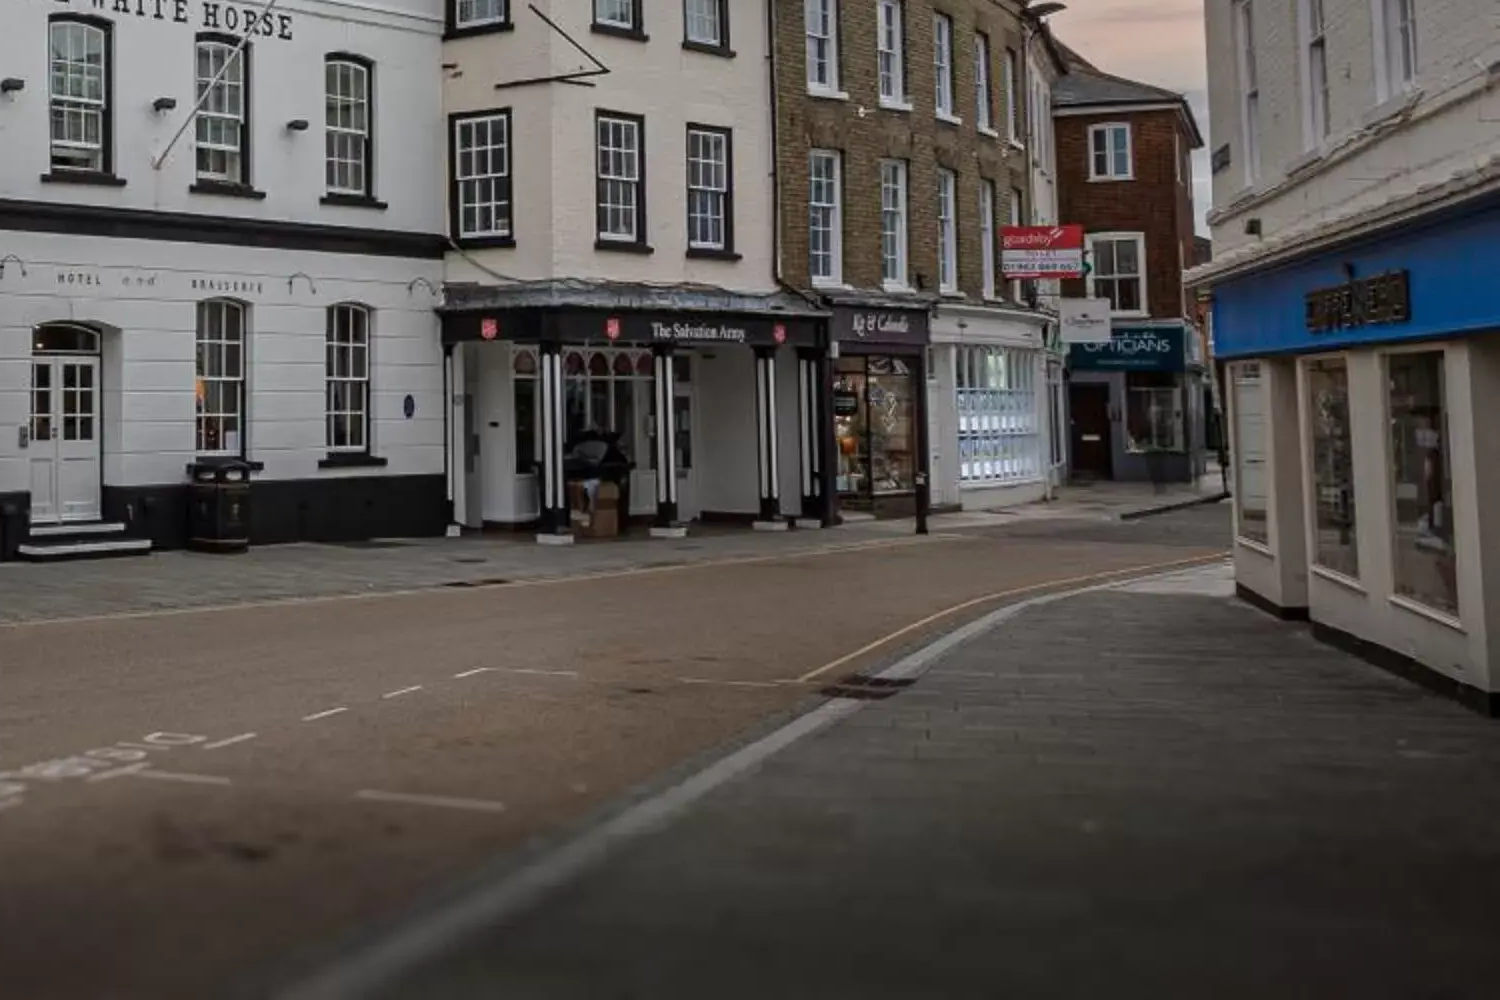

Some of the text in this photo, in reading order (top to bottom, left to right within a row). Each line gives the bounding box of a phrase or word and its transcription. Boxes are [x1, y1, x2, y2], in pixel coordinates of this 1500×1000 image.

[202, 2, 293, 41] HORSE
[57, 272, 101, 285] HOTEL
[651, 321, 746, 344] The Salvation Army
[1082, 339, 1172, 355] OPTICIANS
